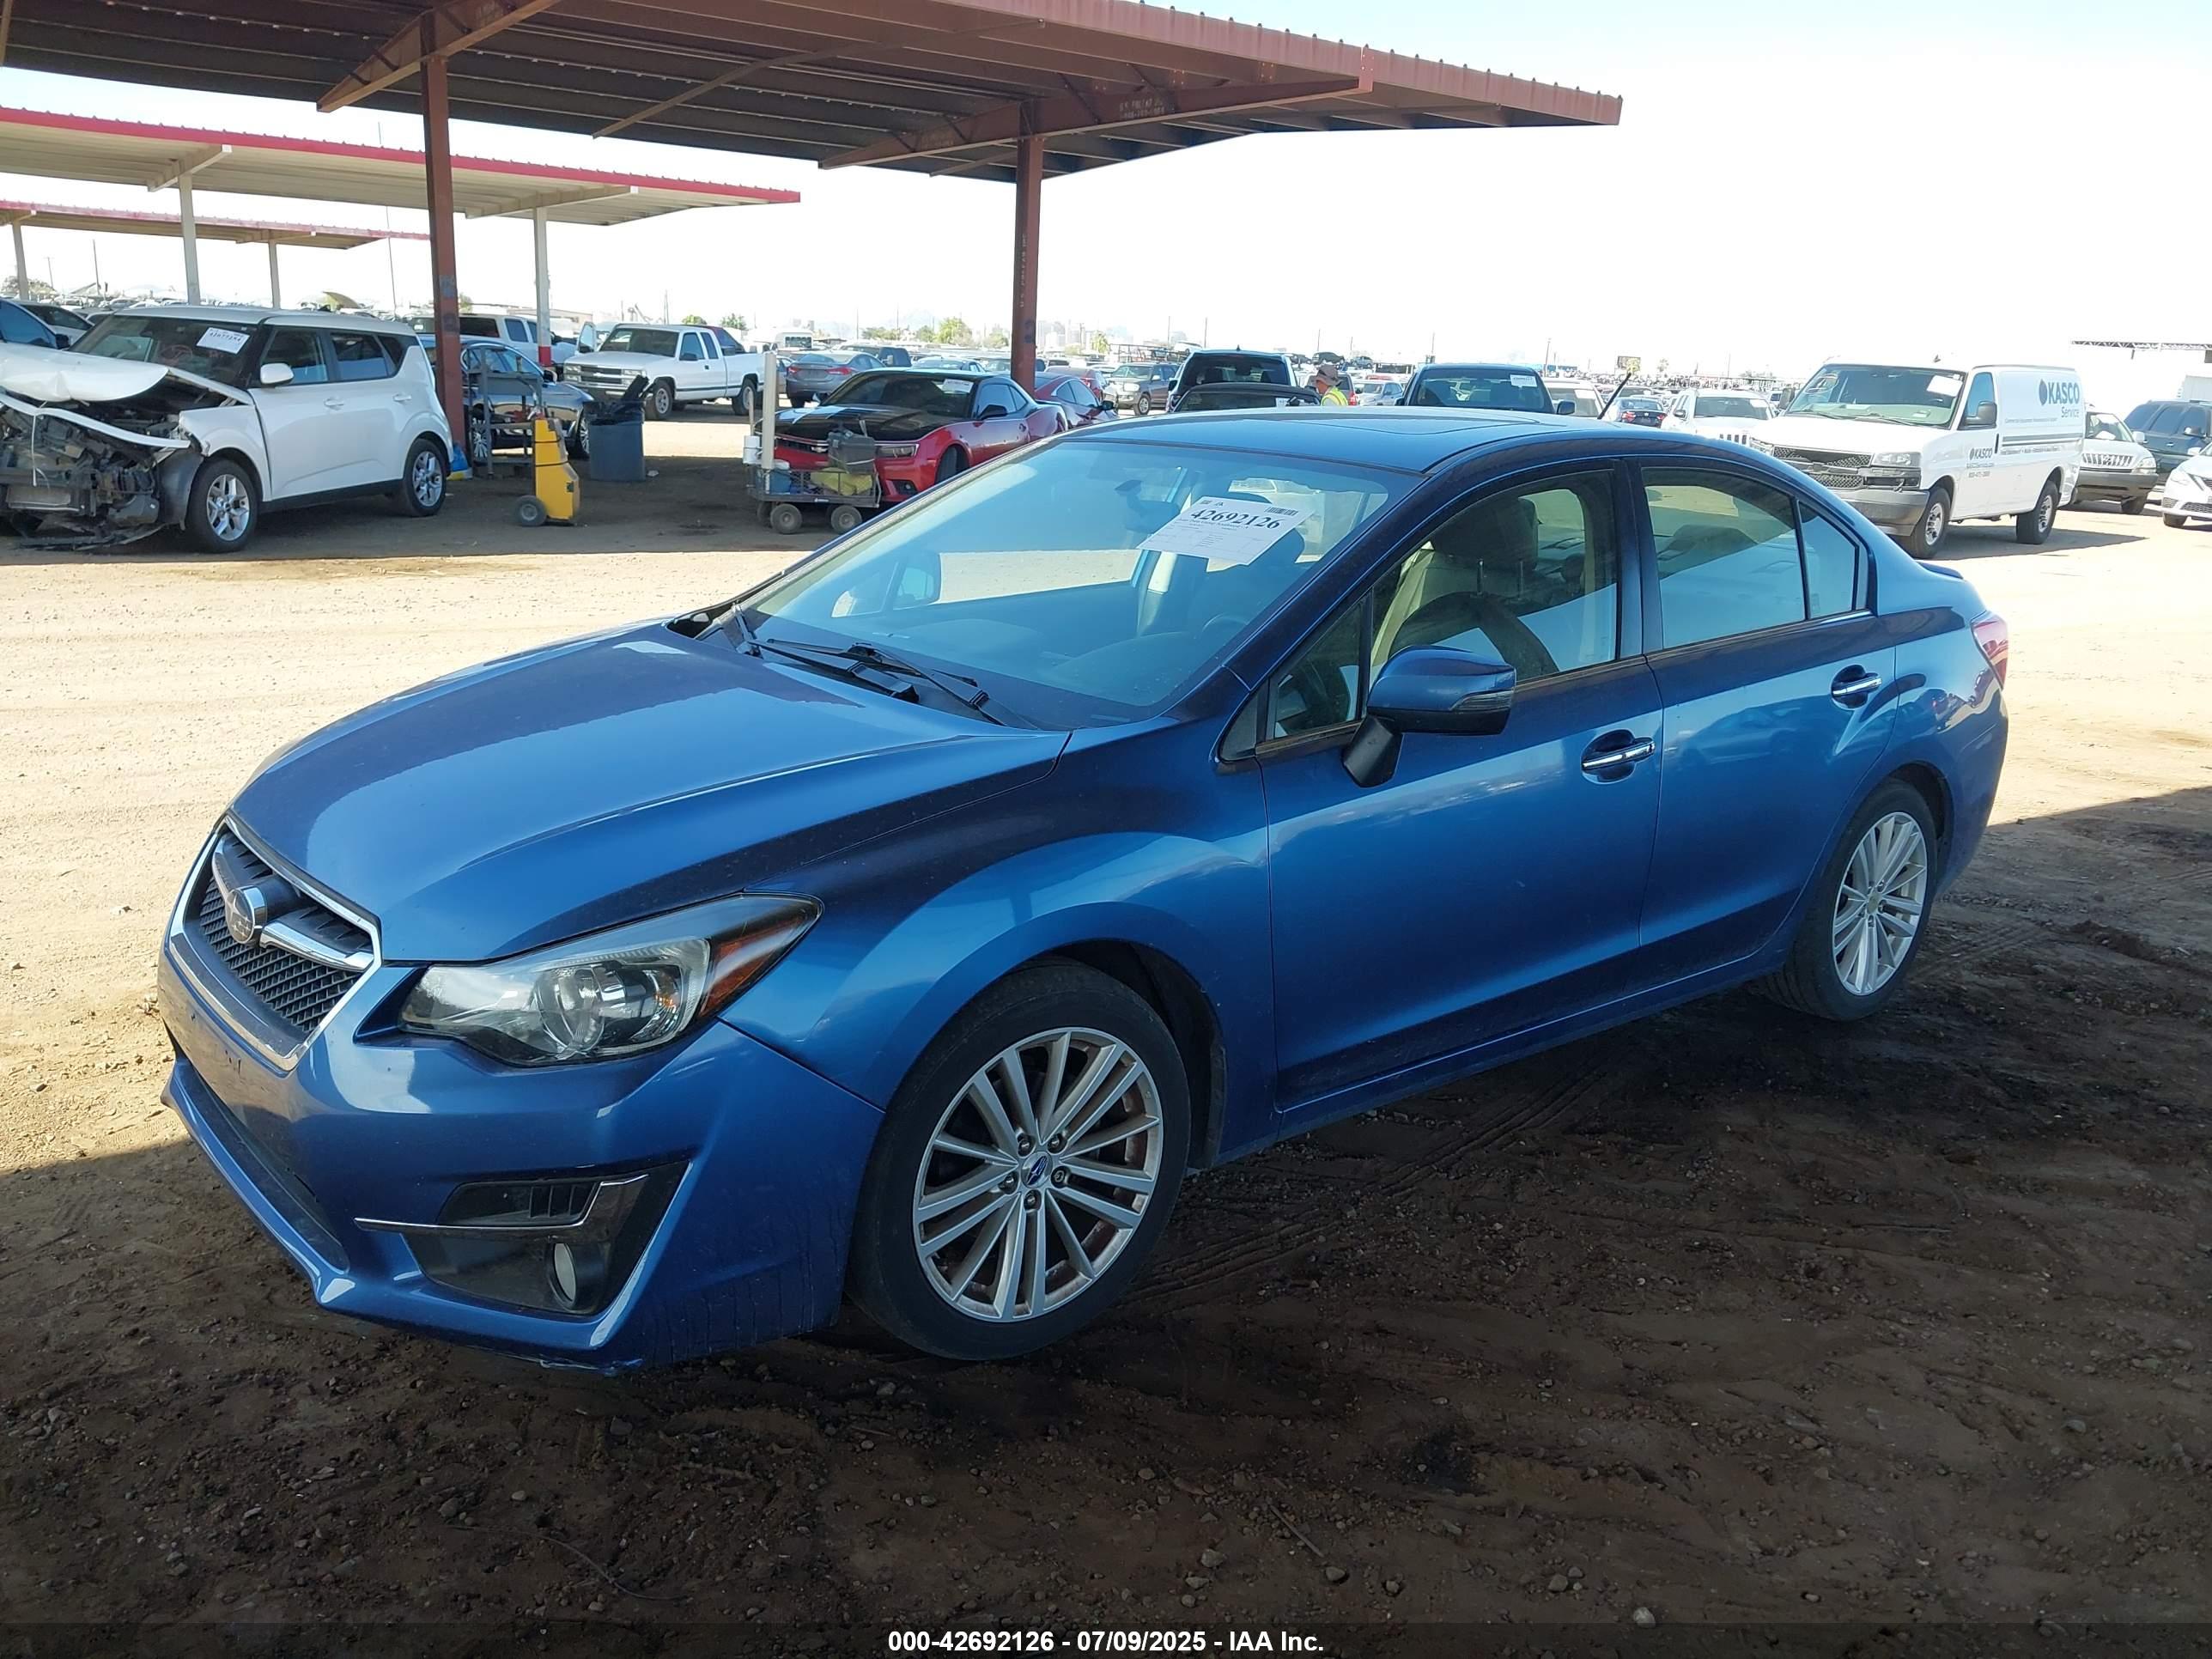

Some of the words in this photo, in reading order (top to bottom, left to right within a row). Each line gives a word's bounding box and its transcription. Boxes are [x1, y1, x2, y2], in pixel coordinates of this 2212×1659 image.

[2048, 382, 2080, 404] KASCO
[2061, 406, 2080, 418] Service
[1974, 448, 1993, 459] KASCO
[1191, 508, 1285, 529] 42692126
